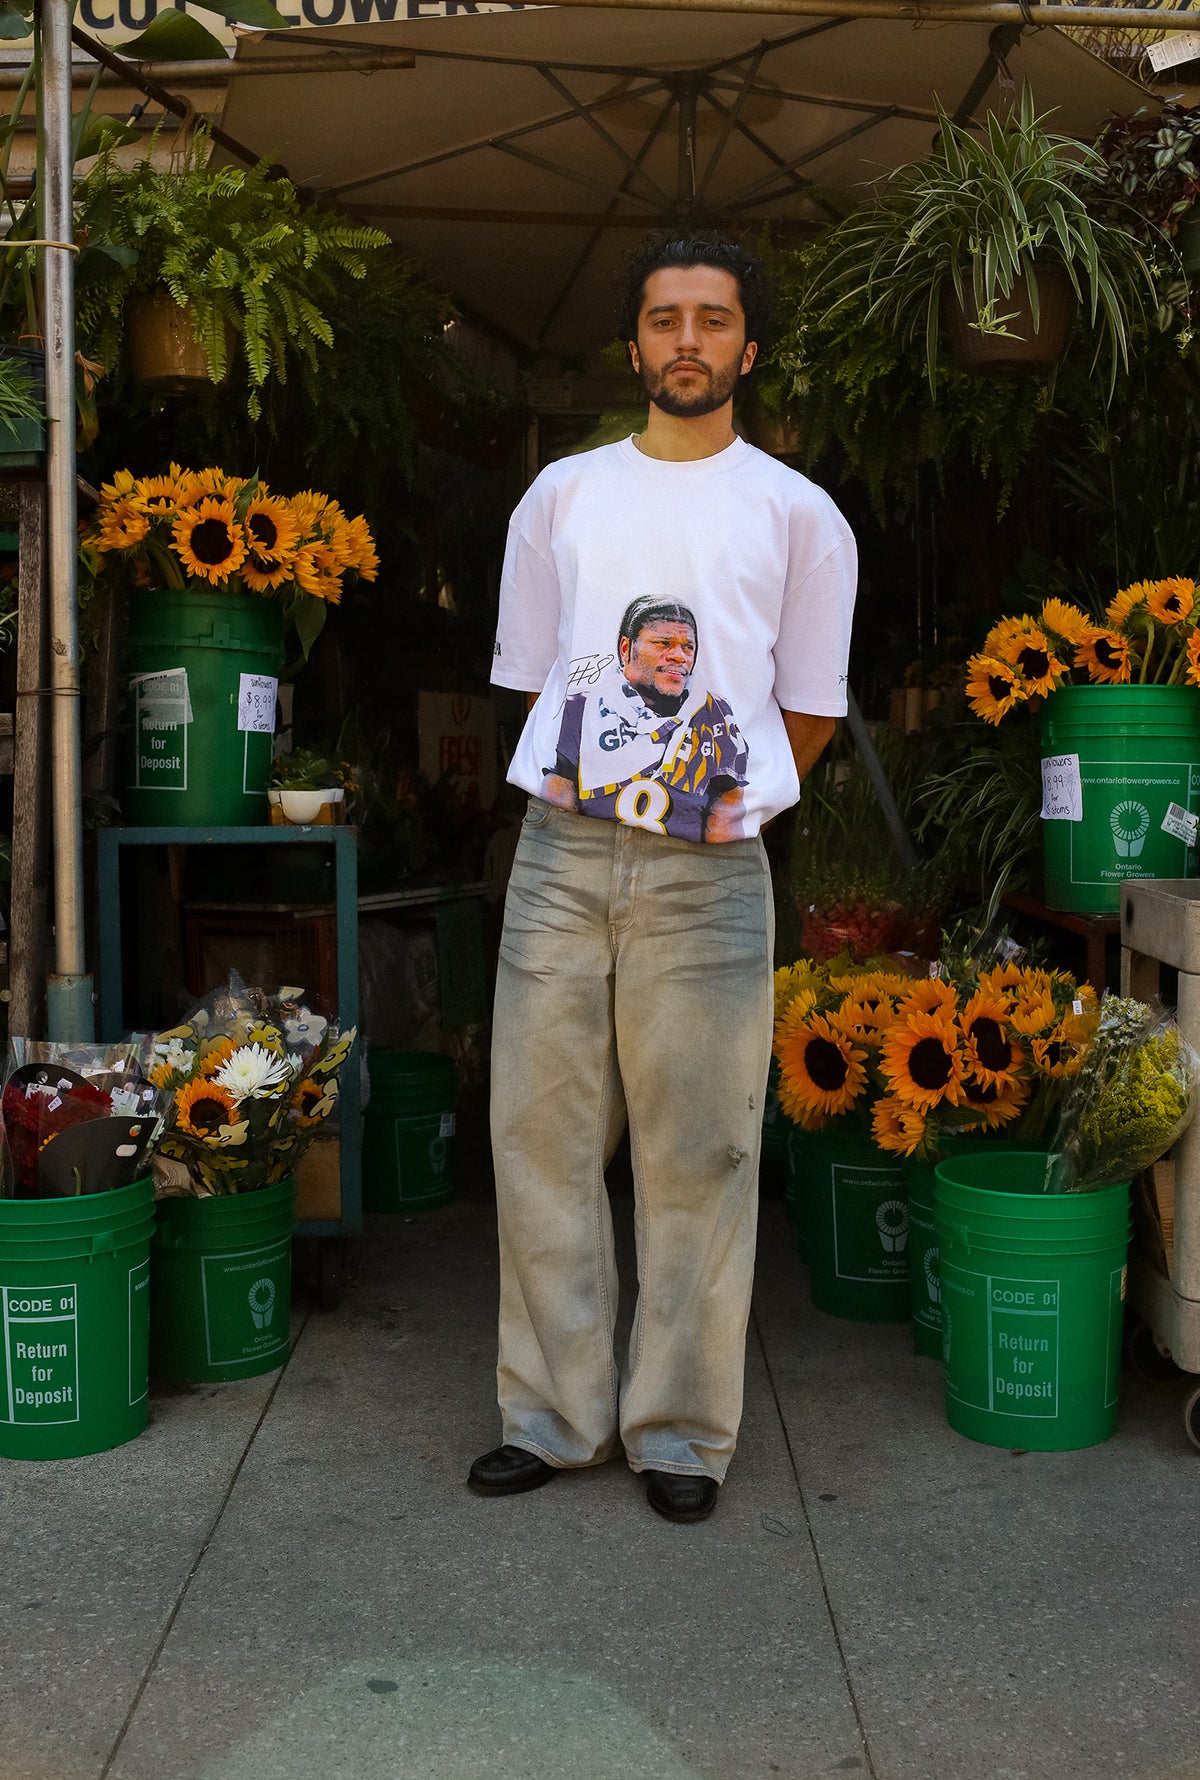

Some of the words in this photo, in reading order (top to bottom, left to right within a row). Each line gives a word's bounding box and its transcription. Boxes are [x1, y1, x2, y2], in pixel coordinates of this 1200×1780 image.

[79, 0, 186, 30] CU
[142, 718, 177, 731] Return
[150, 736, 167, 750] for
[140, 755, 181, 771] Deposit
[1100, 870, 1125, 878] Flower
[1126, 871, 1156, 879] Growers
[1115, 862, 1142, 871] Ontario
[9, 1299, 53, 1313] CODE
[60, 1296, 75, 1311] 01
[992, 1289, 1036, 1305] CODE
[1043, 1292, 1058, 1305] 01
[998, 1332, 1049, 1352] Return
[16, 1342, 68, 1360] Return
[1012, 1356, 1035, 1374] for
[31, 1366, 54, 1383] for
[15, 1386, 74, 1408] Deposit
[995, 1378, 1053, 1400] Deposit
